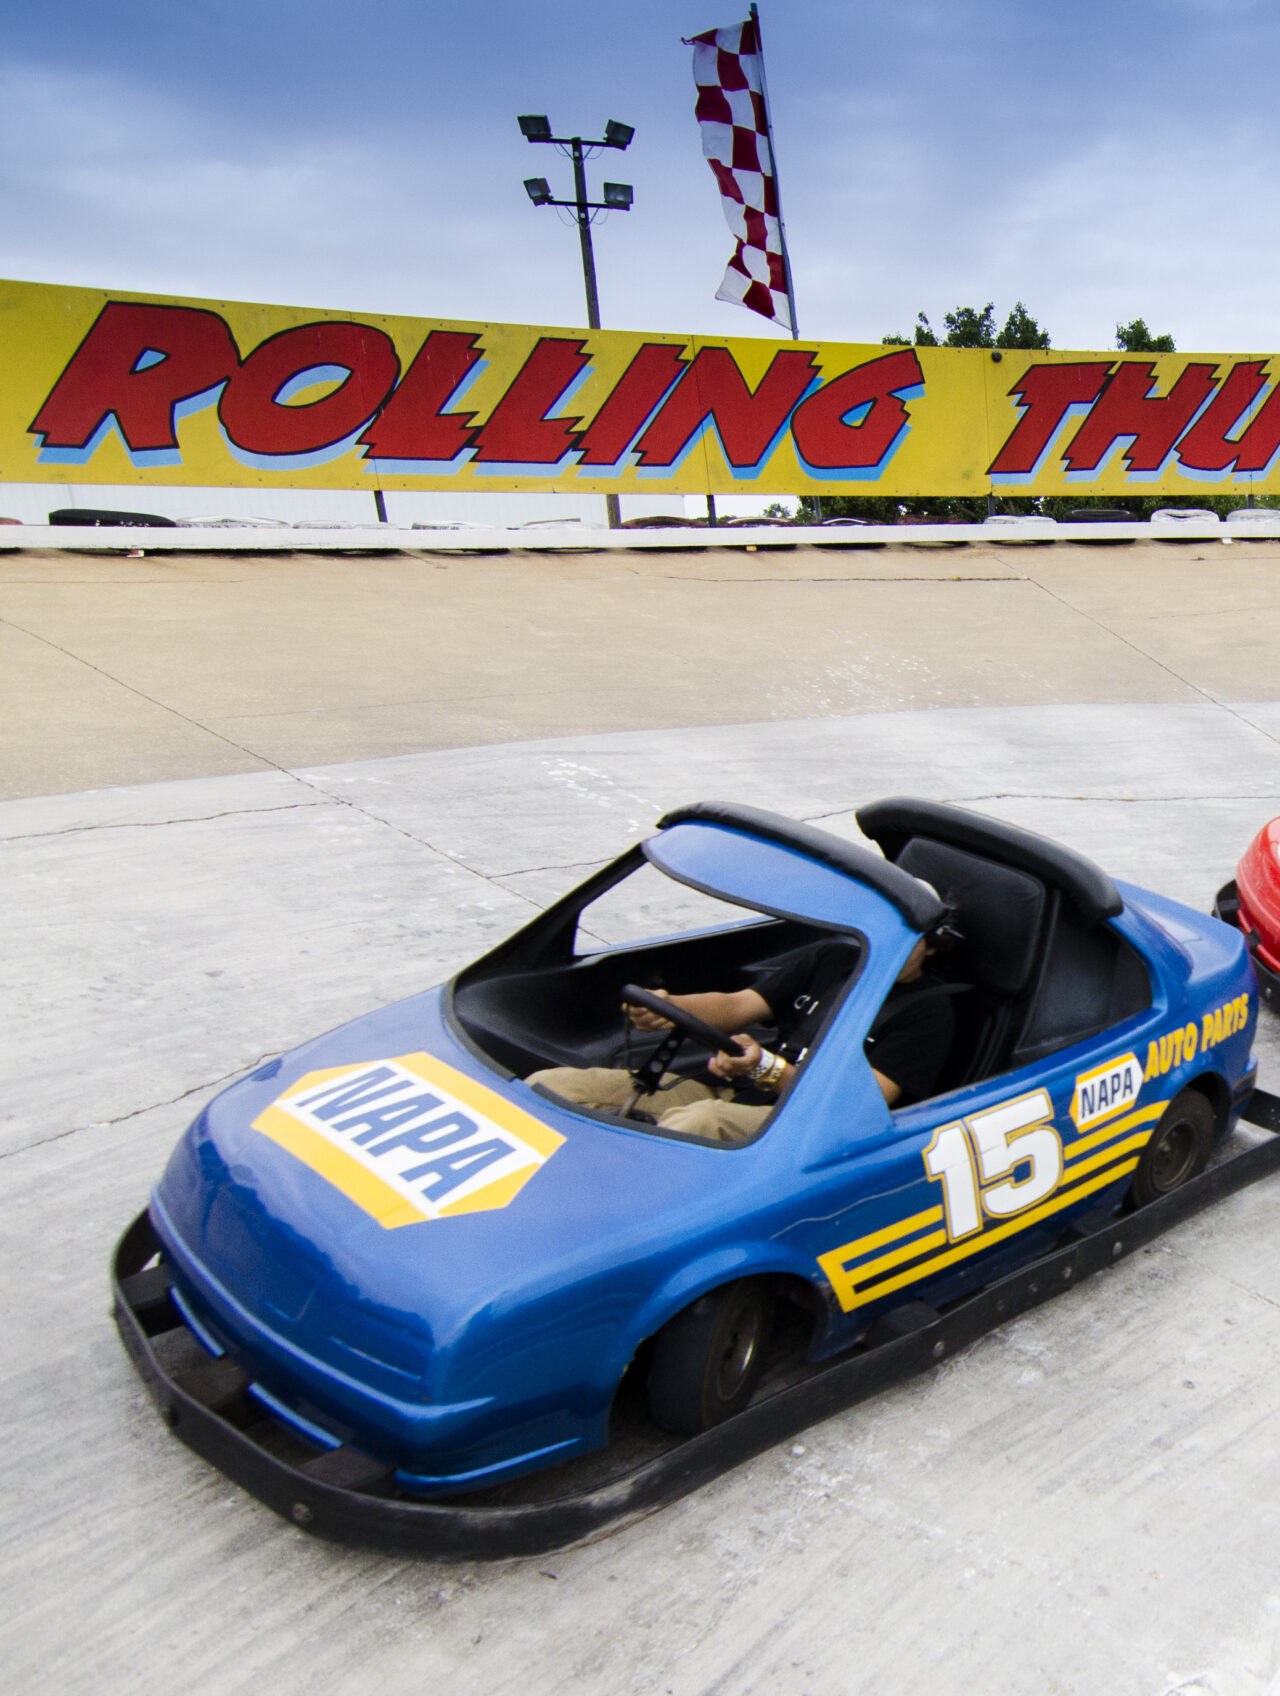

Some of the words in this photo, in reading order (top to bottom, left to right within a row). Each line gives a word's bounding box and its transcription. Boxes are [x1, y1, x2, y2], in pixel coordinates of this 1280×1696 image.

[31, 301, 924, 474] ROLLING
[1080, 1064, 1134, 1117] NAPA
[1143, 1023, 1198, 1082] AUTO
[1201, 993, 1250, 1052] PARTS
[296, 1066, 517, 1203] NAPA
[922, 1087, 1063, 1244] 15
